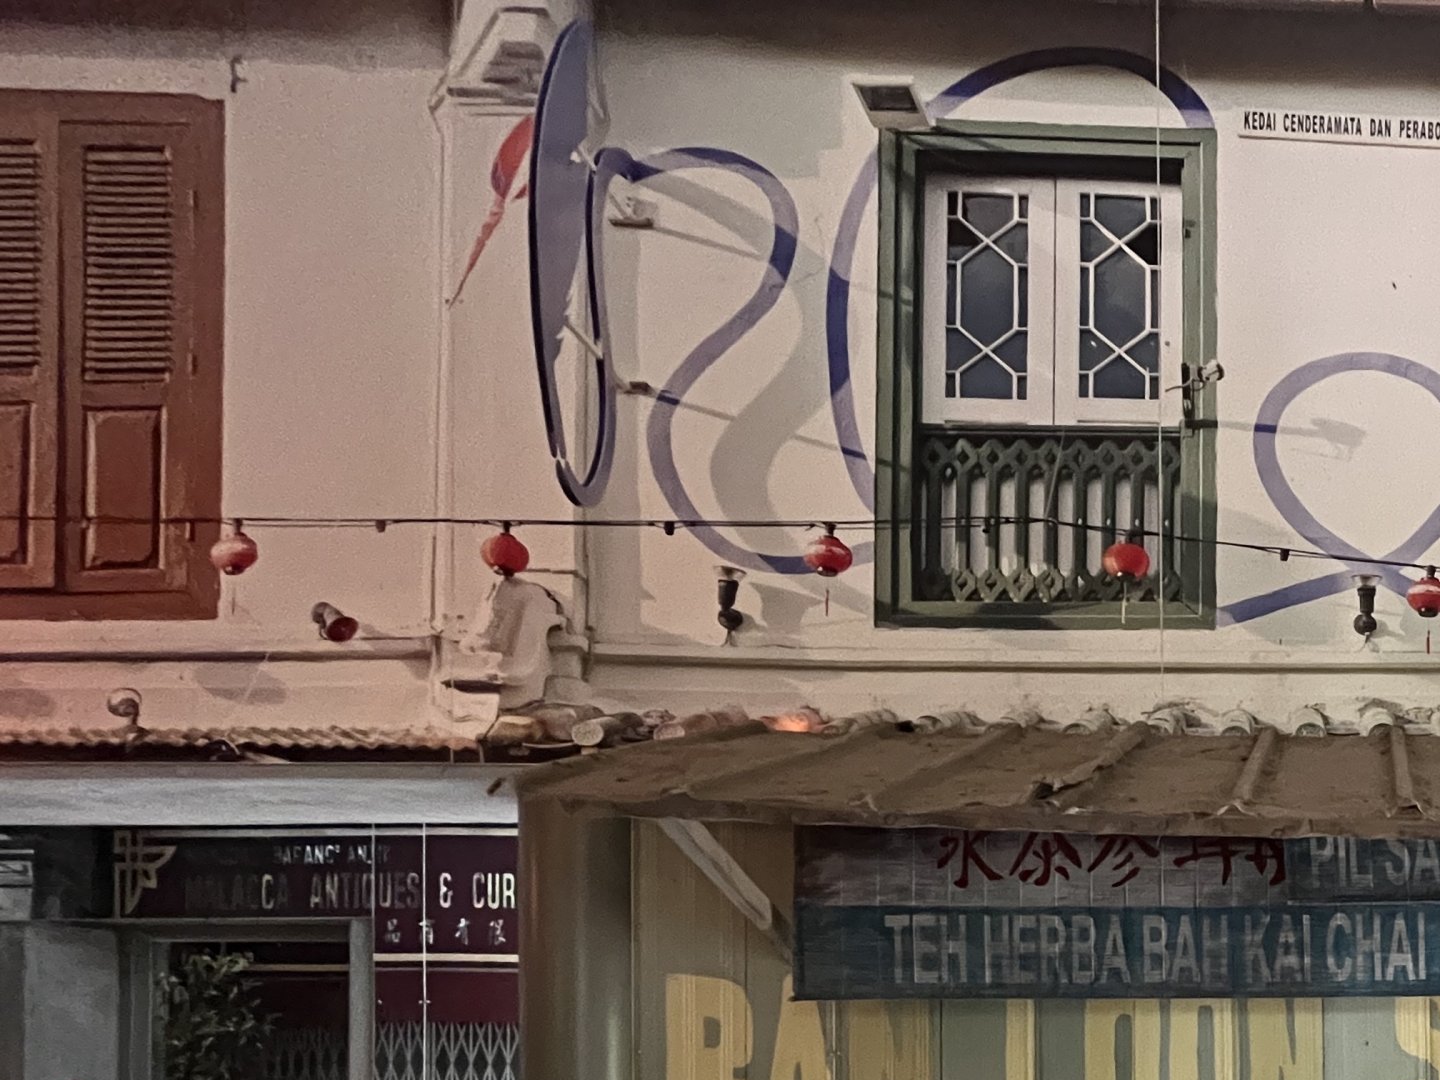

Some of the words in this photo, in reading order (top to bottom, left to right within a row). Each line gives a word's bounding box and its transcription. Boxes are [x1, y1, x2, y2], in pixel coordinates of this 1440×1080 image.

[1244, 111, 1276, 131] KEDAI
[1283, 113, 1362, 136] CENDERAMATA
[1370, 118, 1391, 137] DAN
[1310, 836, 1375, 889] PIL
[310, 872, 420, 909] ANTIQUES
[439, 873, 453, 909] &
[885, 914, 967, 984] TEH
[984, 914, 1130, 984] HERBA
[1245, 913, 1312, 983] KAI
[1326, 911, 1427, 983] CHAI
